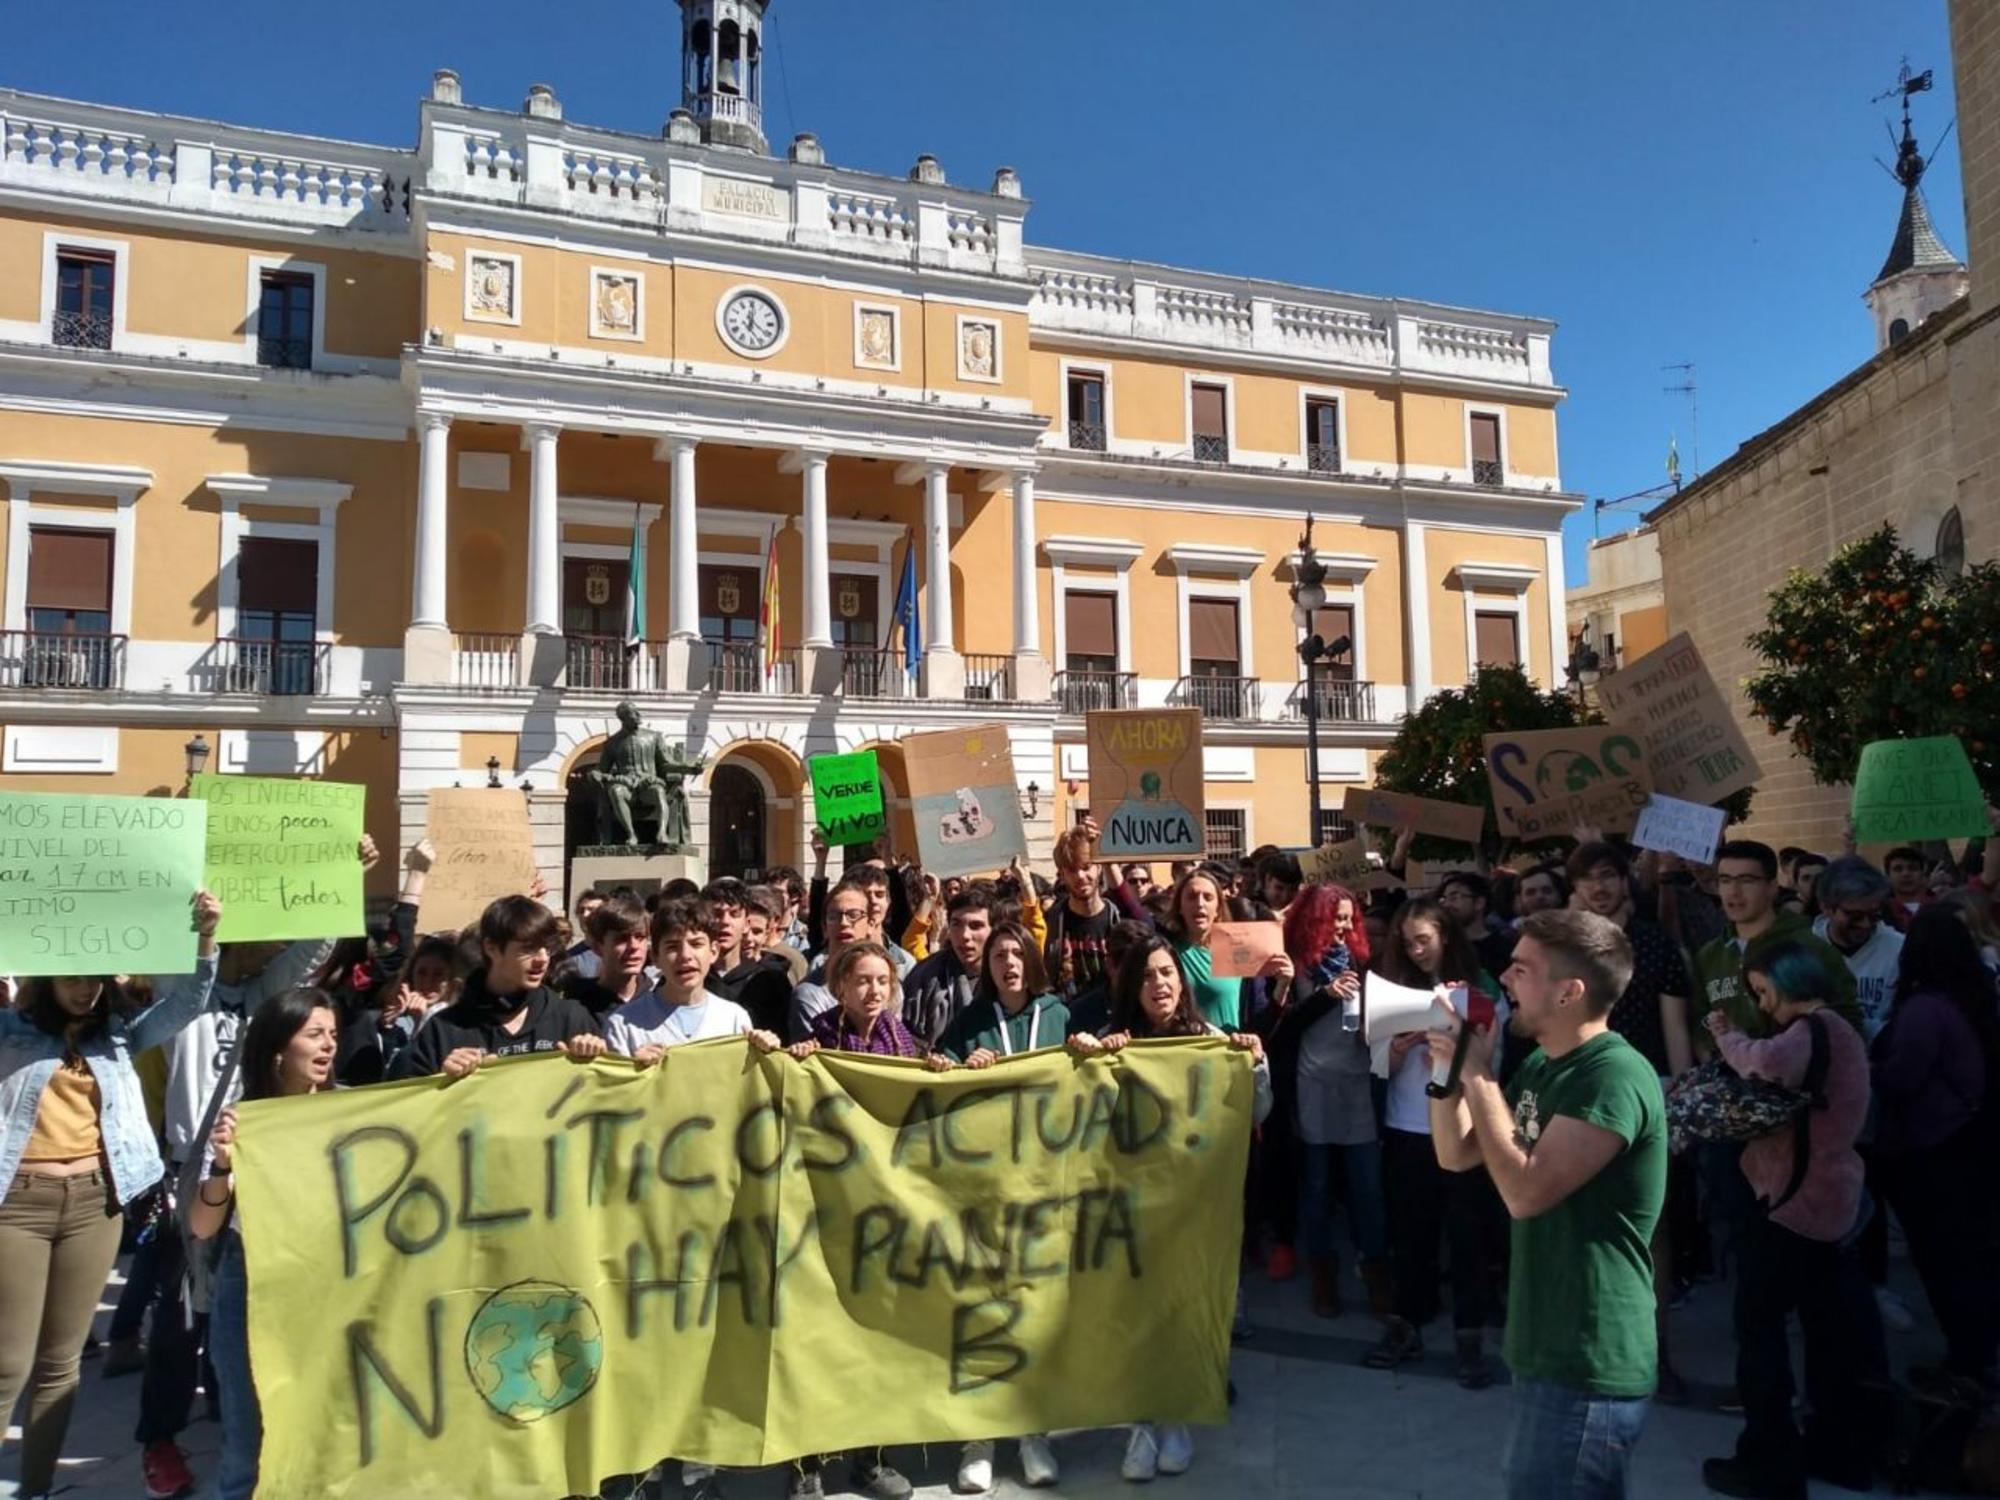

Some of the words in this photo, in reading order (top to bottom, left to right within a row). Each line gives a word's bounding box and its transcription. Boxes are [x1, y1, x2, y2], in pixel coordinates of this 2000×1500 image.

[719, 182, 775, 201] PALACIO
[714, 194, 780, 217] MUNICIPAL
[1107, 718, 1187, 751] AHORA
[244, 782, 357, 812] INTERESES
[819, 780, 874, 800] VERDE
[62, 805, 185, 830] ELEVADO
[275, 815, 333, 842] pocos
[817, 812, 879, 838] VIVO
[1110, 815, 1194, 846] NUNCA
[84, 838, 129, 857] DEL
[1316, 848, 1343, 868] NO
[47, 862, 87, 889] 17
[95, 869, 127, 887] CM
[138, 870, 172, 888] EN
[0, 896, 76, 916] TIMO
[209, 876, 271, 903] OBRE
[272, 875, 349, 911] todos
[31, 924, 149, 957] SIGLO
[512, 1042, 529, 1054] THE
[328, 1076, 858, 1279] POLÍTICOS
[892, 1064, 1208, 1170] ACTUAD!
[626, 1207, 825, 1341] HAY
[850, 1186, 1143, 1296] PLANETA
[949, 1300, 1030, 1395] B
